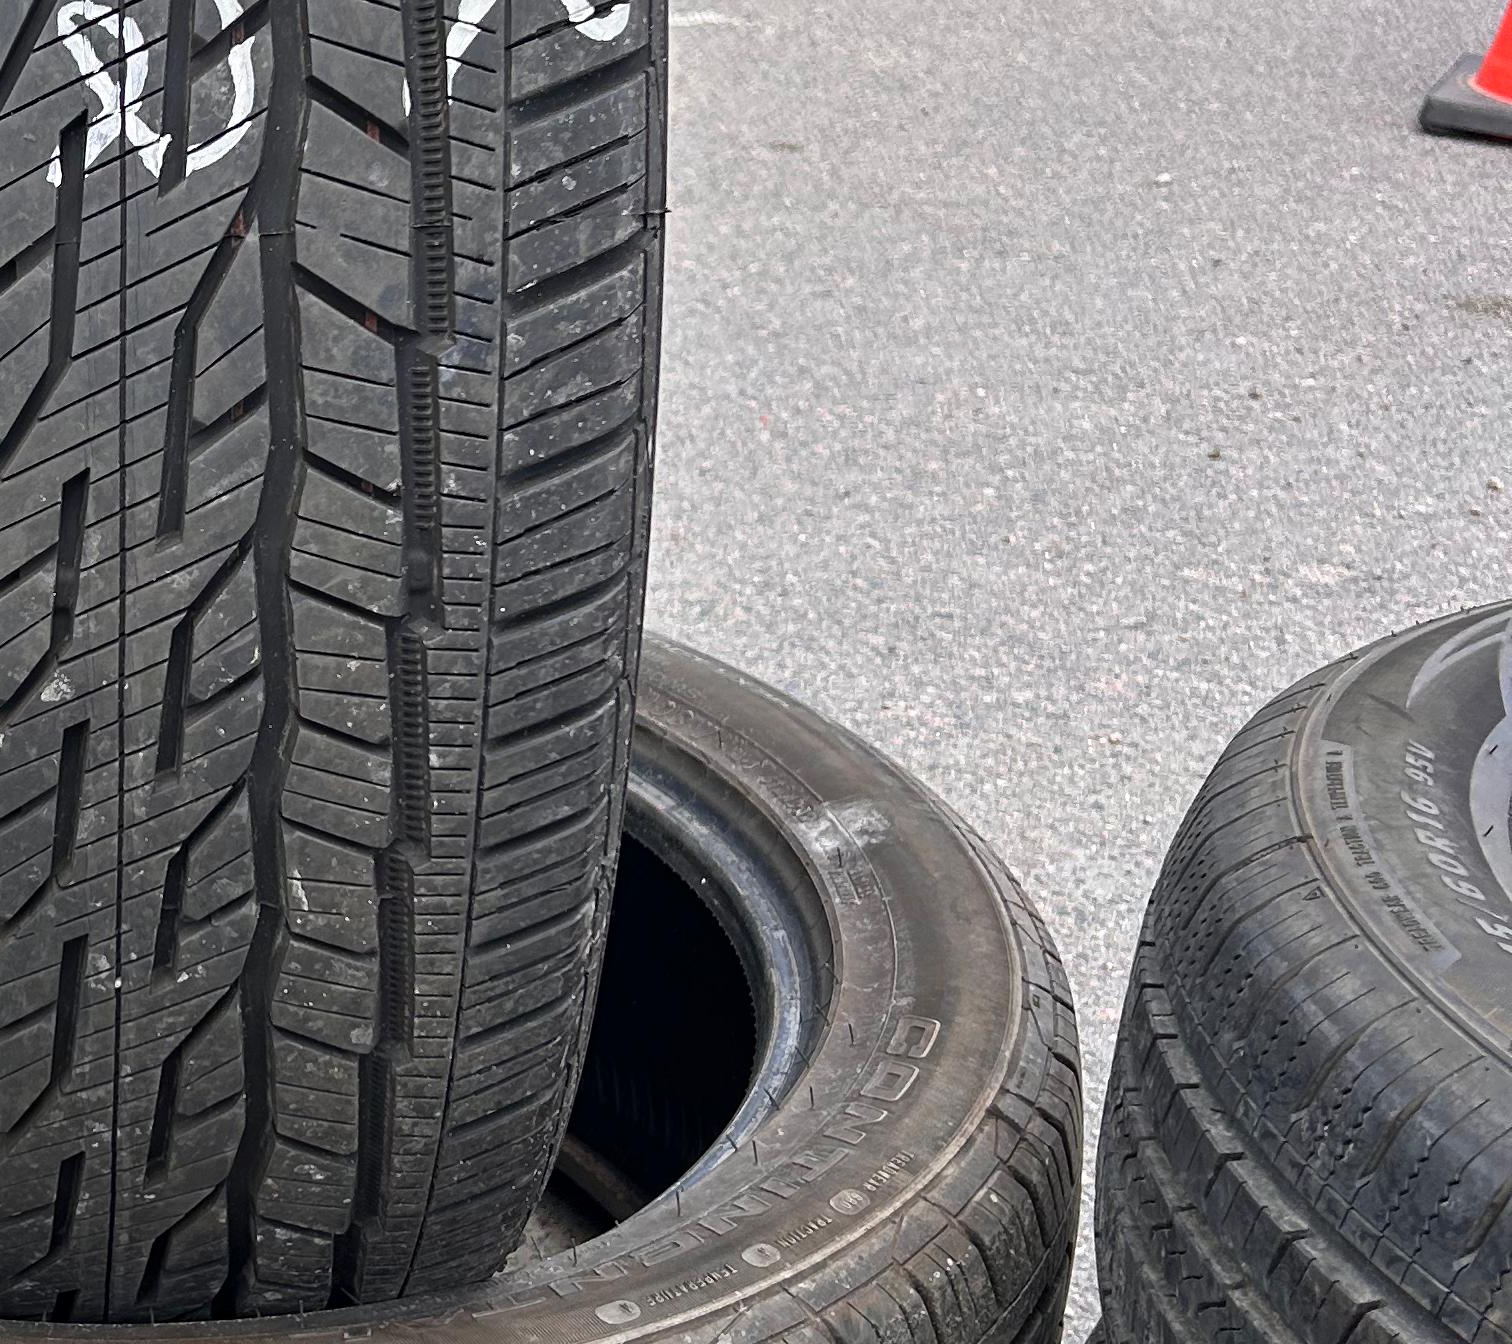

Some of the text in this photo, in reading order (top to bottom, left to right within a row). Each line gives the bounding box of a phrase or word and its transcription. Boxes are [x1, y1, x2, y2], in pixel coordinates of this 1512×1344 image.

[1404, 739, 1435, 786] 95V
[862, 1149, 916, 1192] TREADWEAR
[776, 1214, 834, 1249] TRACTION
[648, 1262, 739, 1307] TEMPERATURE
